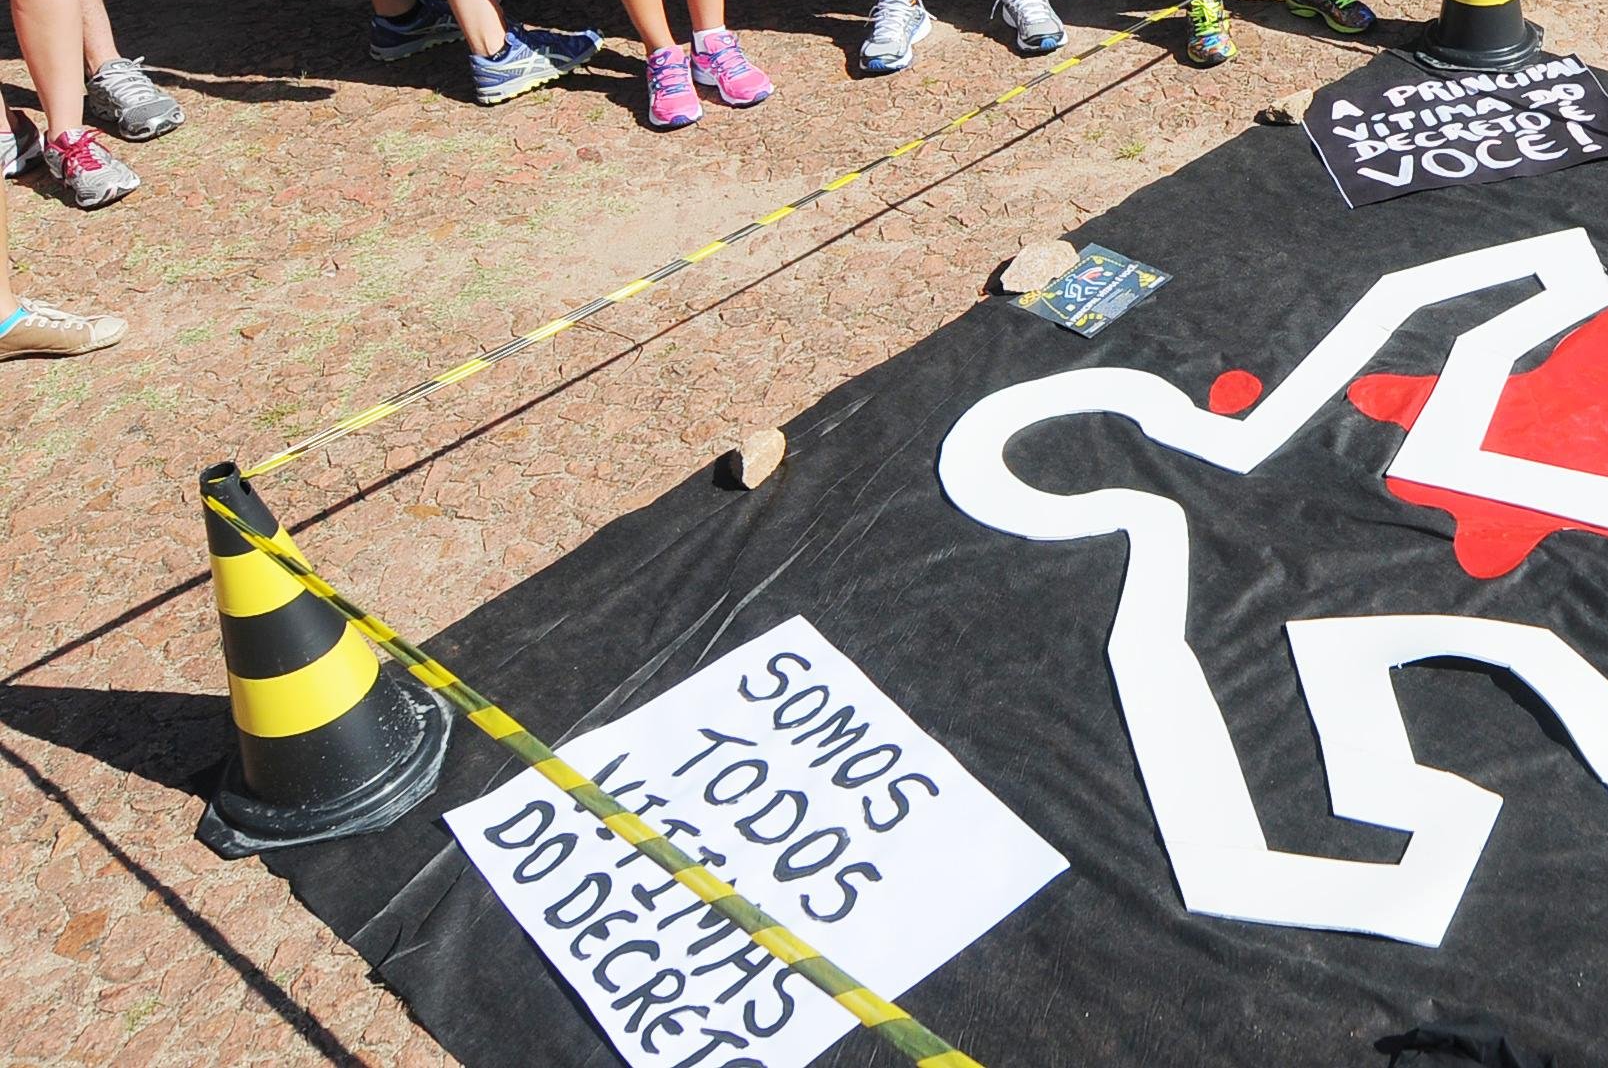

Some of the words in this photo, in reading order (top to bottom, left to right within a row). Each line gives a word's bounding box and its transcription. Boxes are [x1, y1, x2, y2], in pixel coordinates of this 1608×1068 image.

[1332, 99, 1364, 120] A
[1383, 57, 1588, 108] PRINCIPAL
[1332, 97, 1512, 141] VÍTIMA
[1521, 83, 1585, 109] DO
[1348, 111, 1551, 163] DECRETO
[738, 651, 941, 833] SOMOS
[672, 727, 883, 923] TODOS
[483, 800, 579, 885] DO
[543, 871, 769, 1068] DECRET
